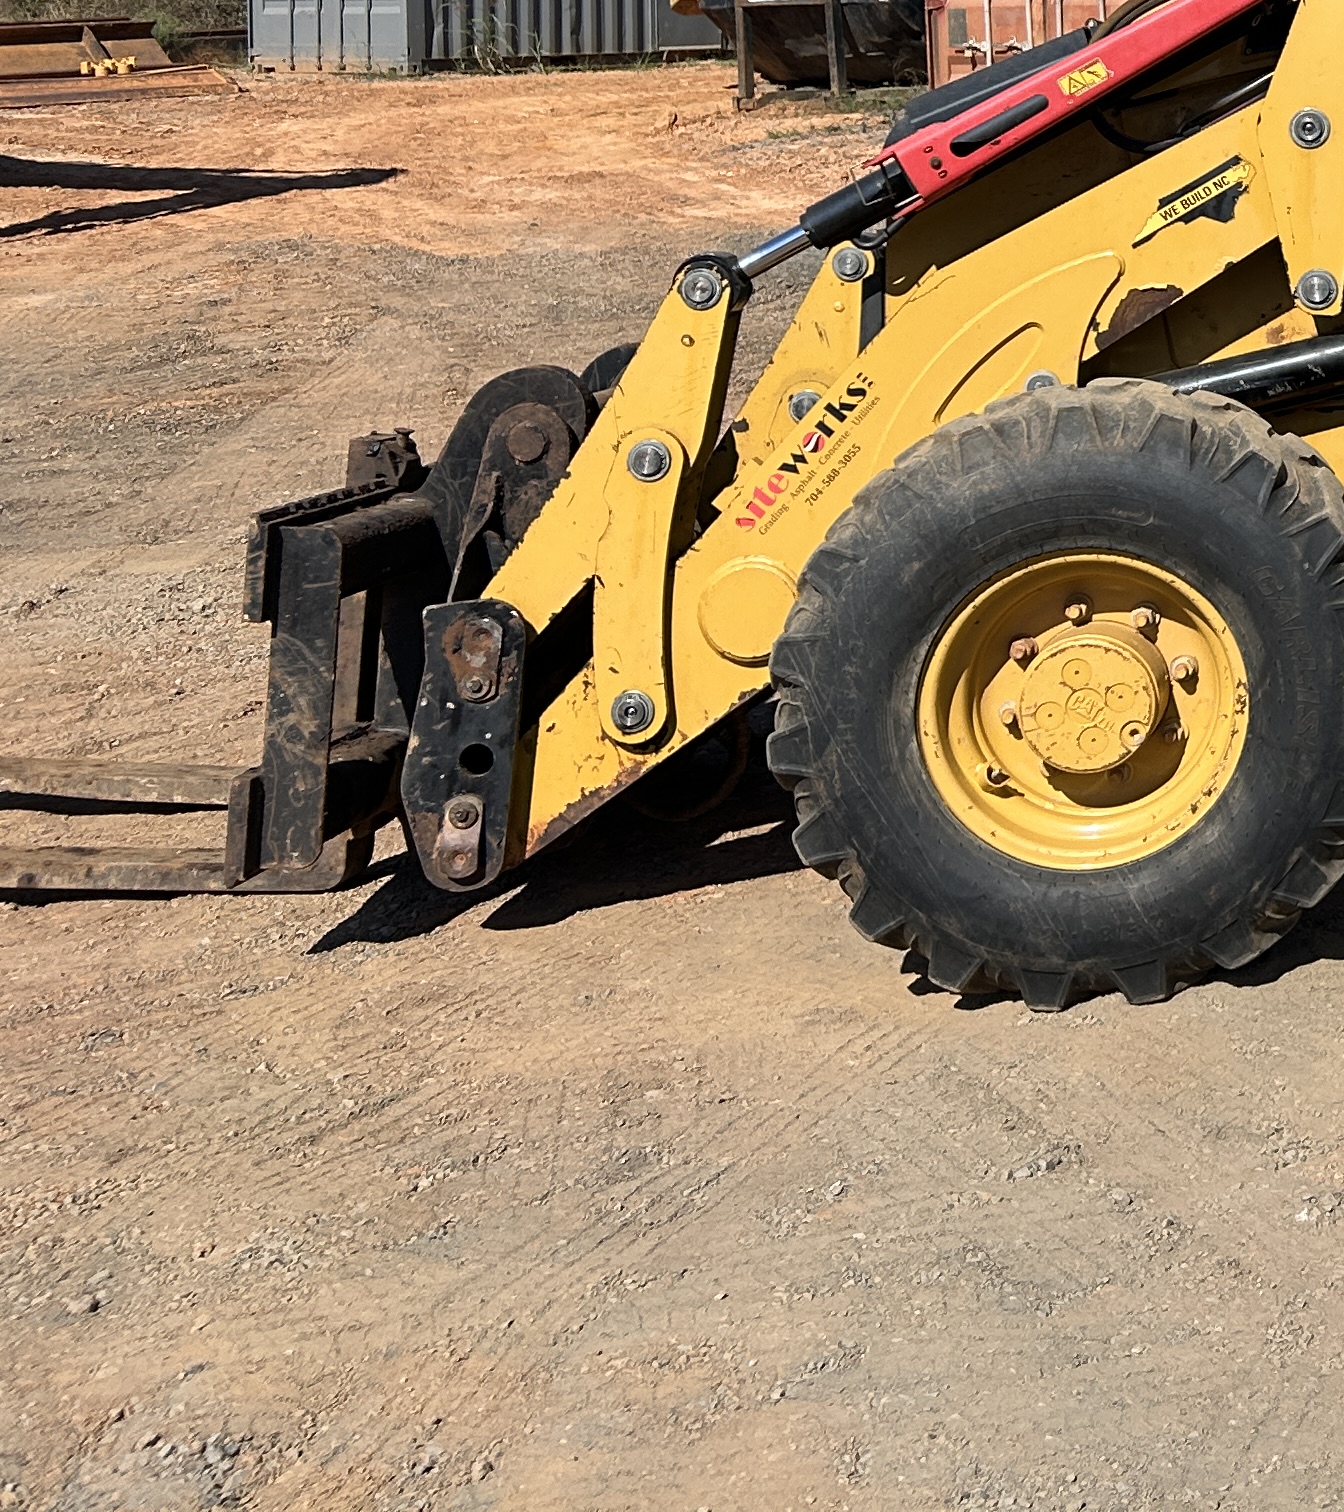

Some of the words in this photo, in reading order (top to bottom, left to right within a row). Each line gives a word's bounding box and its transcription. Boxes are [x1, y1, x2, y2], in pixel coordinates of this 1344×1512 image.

[1160, 204, 1181, 221] WE
[1180, 186, 1213, 210] BUILD
[1212, 175, 1231, 191] NC
[758, 503, 790, 535] Grading
[790, 470, 818, 500] Asphalt
[818, 430, 851, 465] Concrete
[851, 396, 881, 426] Utilities
[805, 443, 862, 506] 704-588-3055
